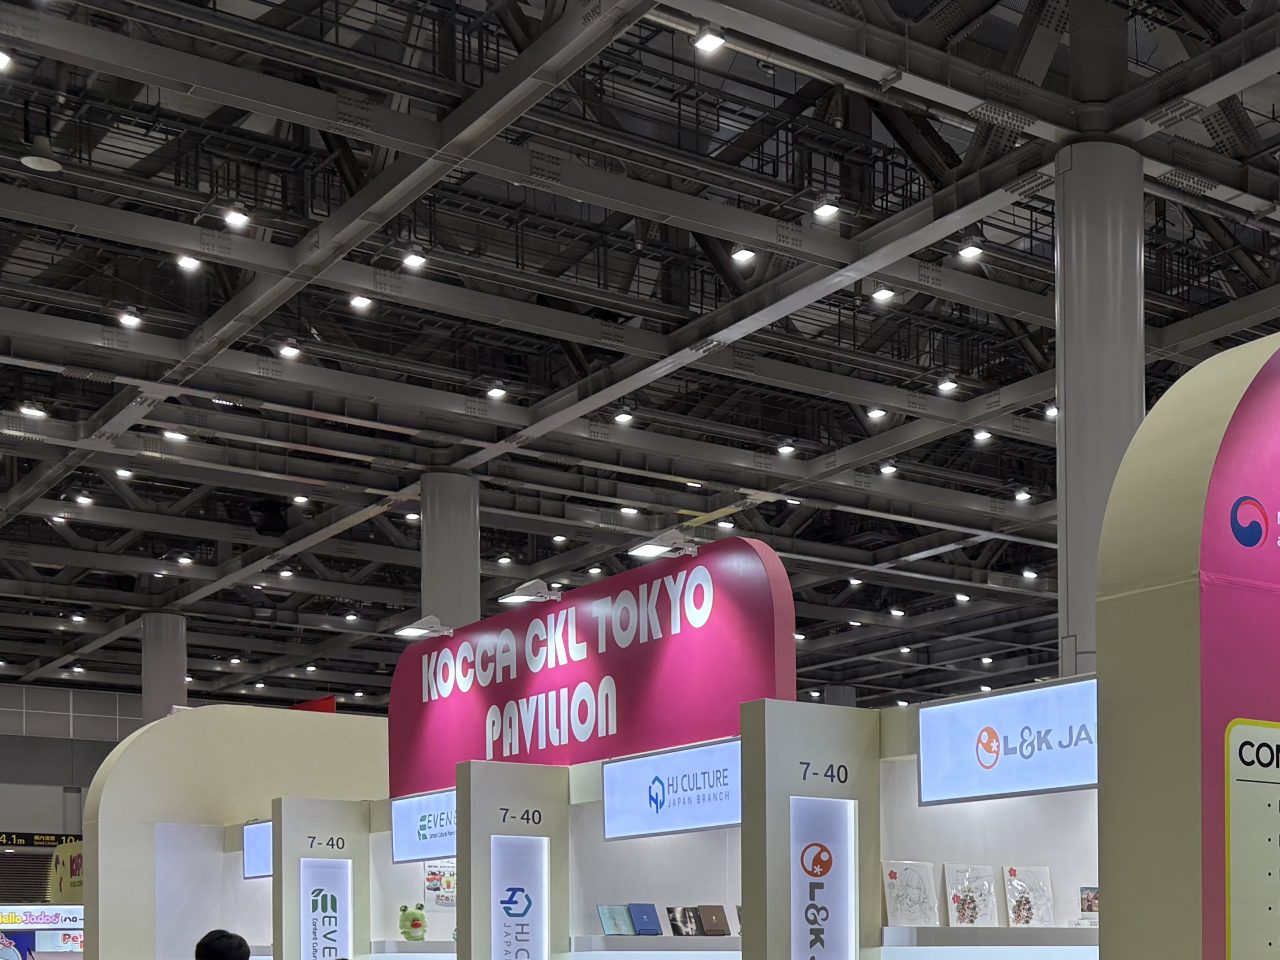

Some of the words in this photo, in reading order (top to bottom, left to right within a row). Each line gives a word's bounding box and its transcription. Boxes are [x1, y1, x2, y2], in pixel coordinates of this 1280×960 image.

[422, 628, 516, 703] KOCCA
[525, 607, 588, 673] CKL
[591, 565, 714, 654] TOKYO
[486, 675, 616, 760] PAVILION
[1003, 726, 1053, 760] L&K
[1058, 723, 1097, 749] JA
[667, 776, 678, 794] HJ
[681, 768, 728, 792] CULTURE
[799, 761, 848, 784] 7-40
[668, 796, 692, 808] JAPAN
[697, 791, 730, 804] BRANCH
[499, 807, 542, 825] 7-40
[307, 835, 345, 850] 7-40
[805, 882, 829, 949] L&K
[515, 923, 530, 942] HJ
